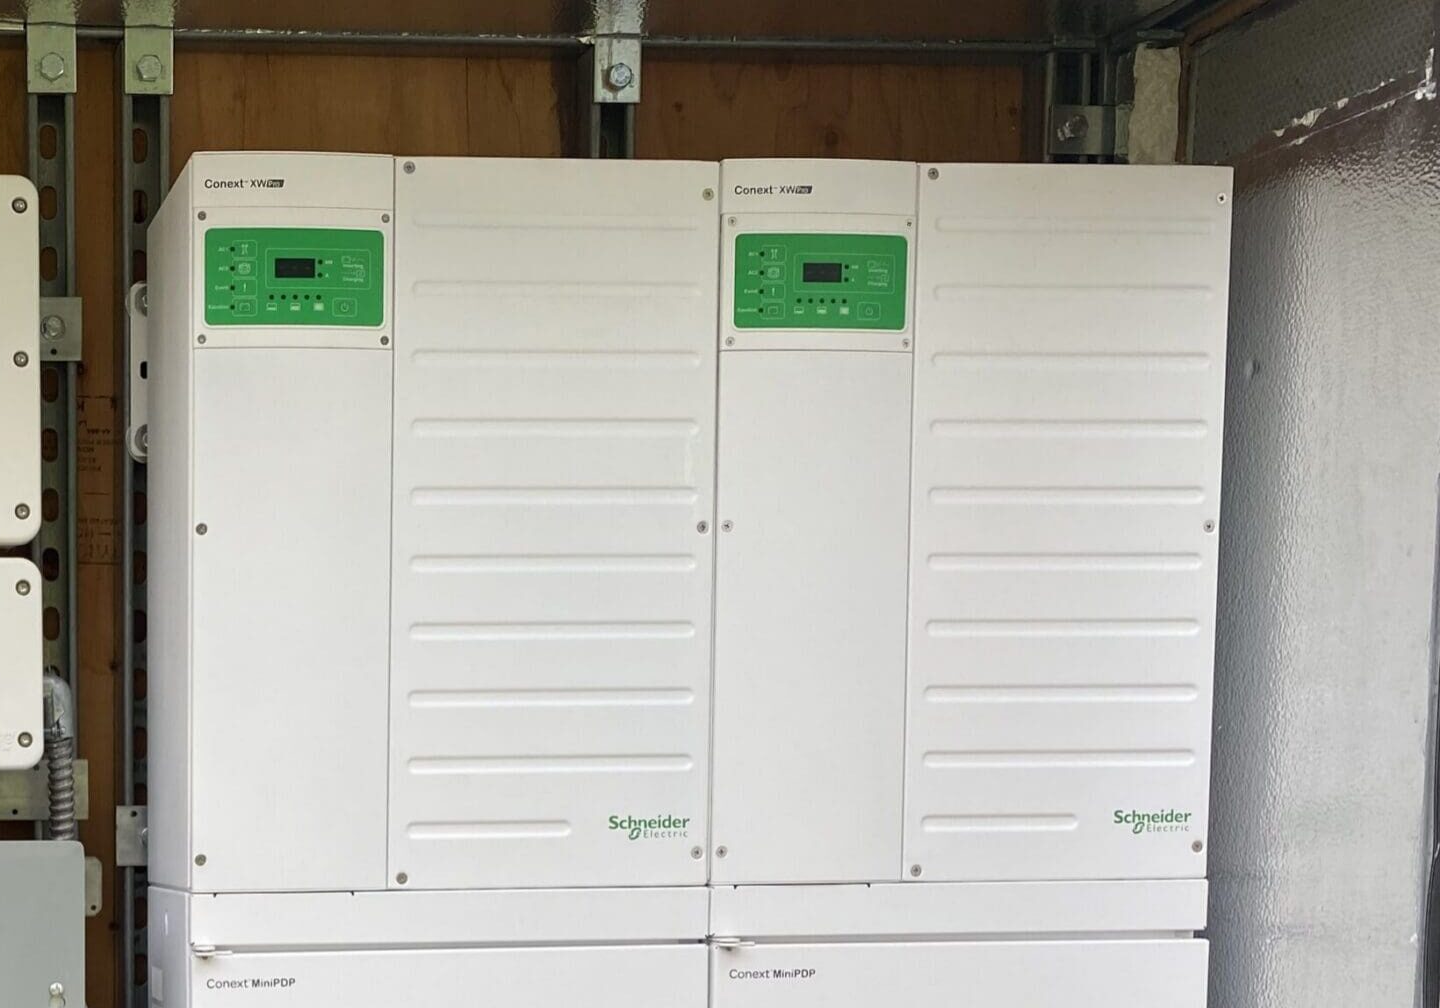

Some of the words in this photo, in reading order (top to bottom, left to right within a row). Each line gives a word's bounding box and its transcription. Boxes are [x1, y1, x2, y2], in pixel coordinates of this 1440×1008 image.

[204, 178, 245, 189] Conext
[734, 185, 773, 196] Conext
[608, 813, 690, 830] Schneider
[1113, 808, 1192, 825] Schneider
[1146, 823, 1190, 833] Electric
[643, 830, 689, 839] Electric
[729, 968, 770, 979] Conext
[773, 968, 816, 979] MiniPDP
[206, 978, 248, 989] Conext
[251, 978, 296, 988] MiniPDP
